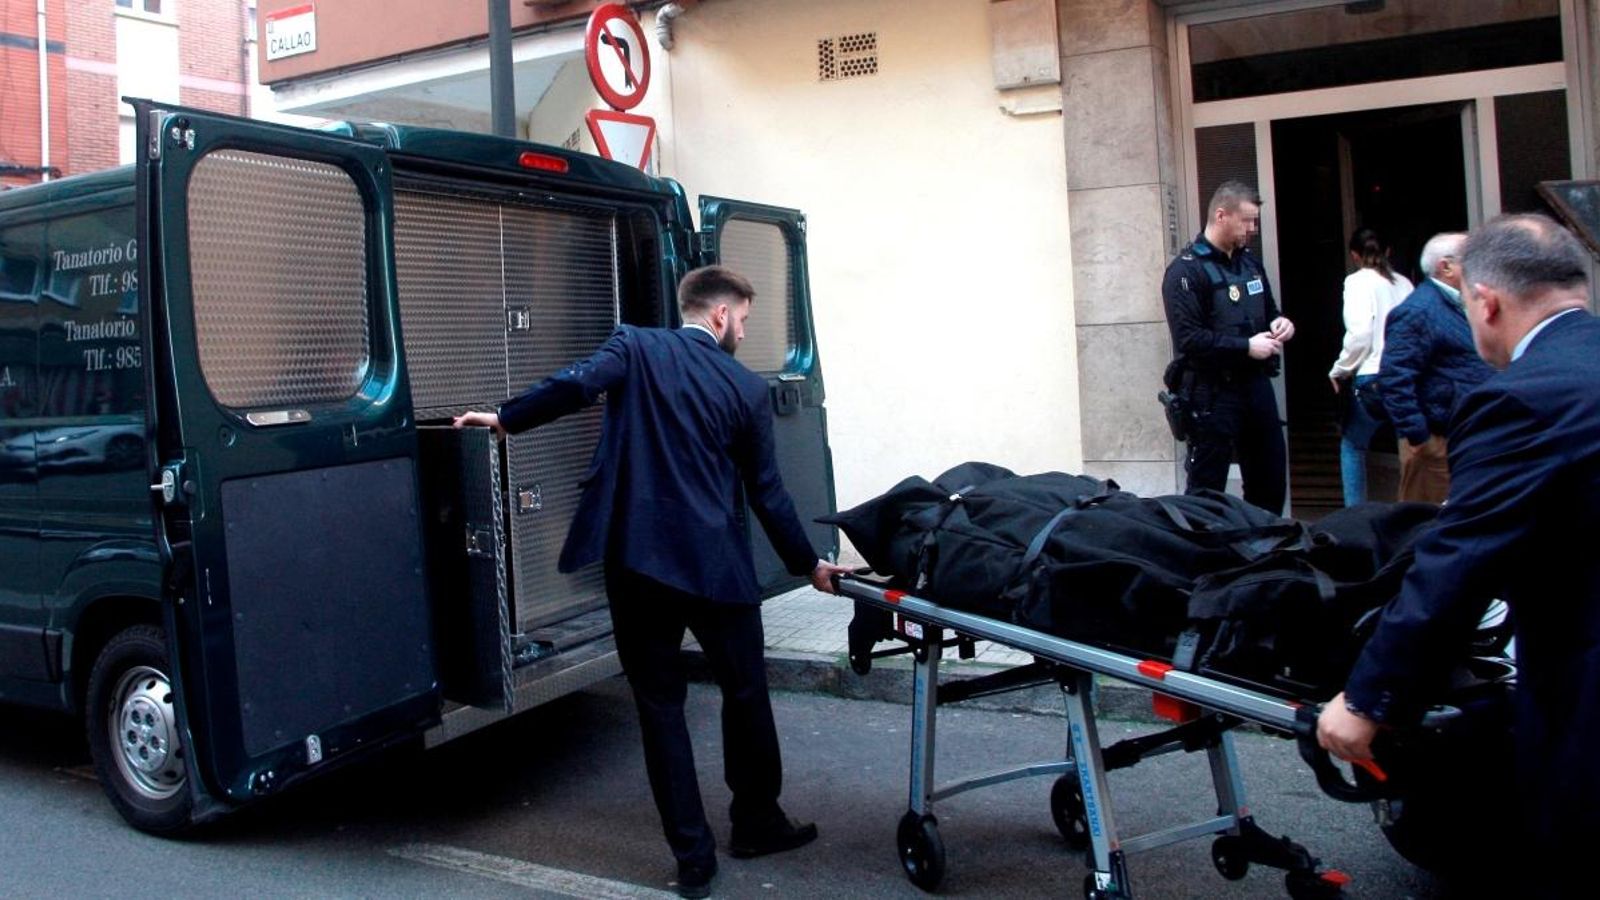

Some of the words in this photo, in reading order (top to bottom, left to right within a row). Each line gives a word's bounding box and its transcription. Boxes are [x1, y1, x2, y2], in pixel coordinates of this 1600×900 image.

[271, 31, 311, 54] CALLAO
[54, 242, 122, 271] Tanatorio
[64, 315, 135, 342] Tanatorio
[116, 346, 142, 369] 985
